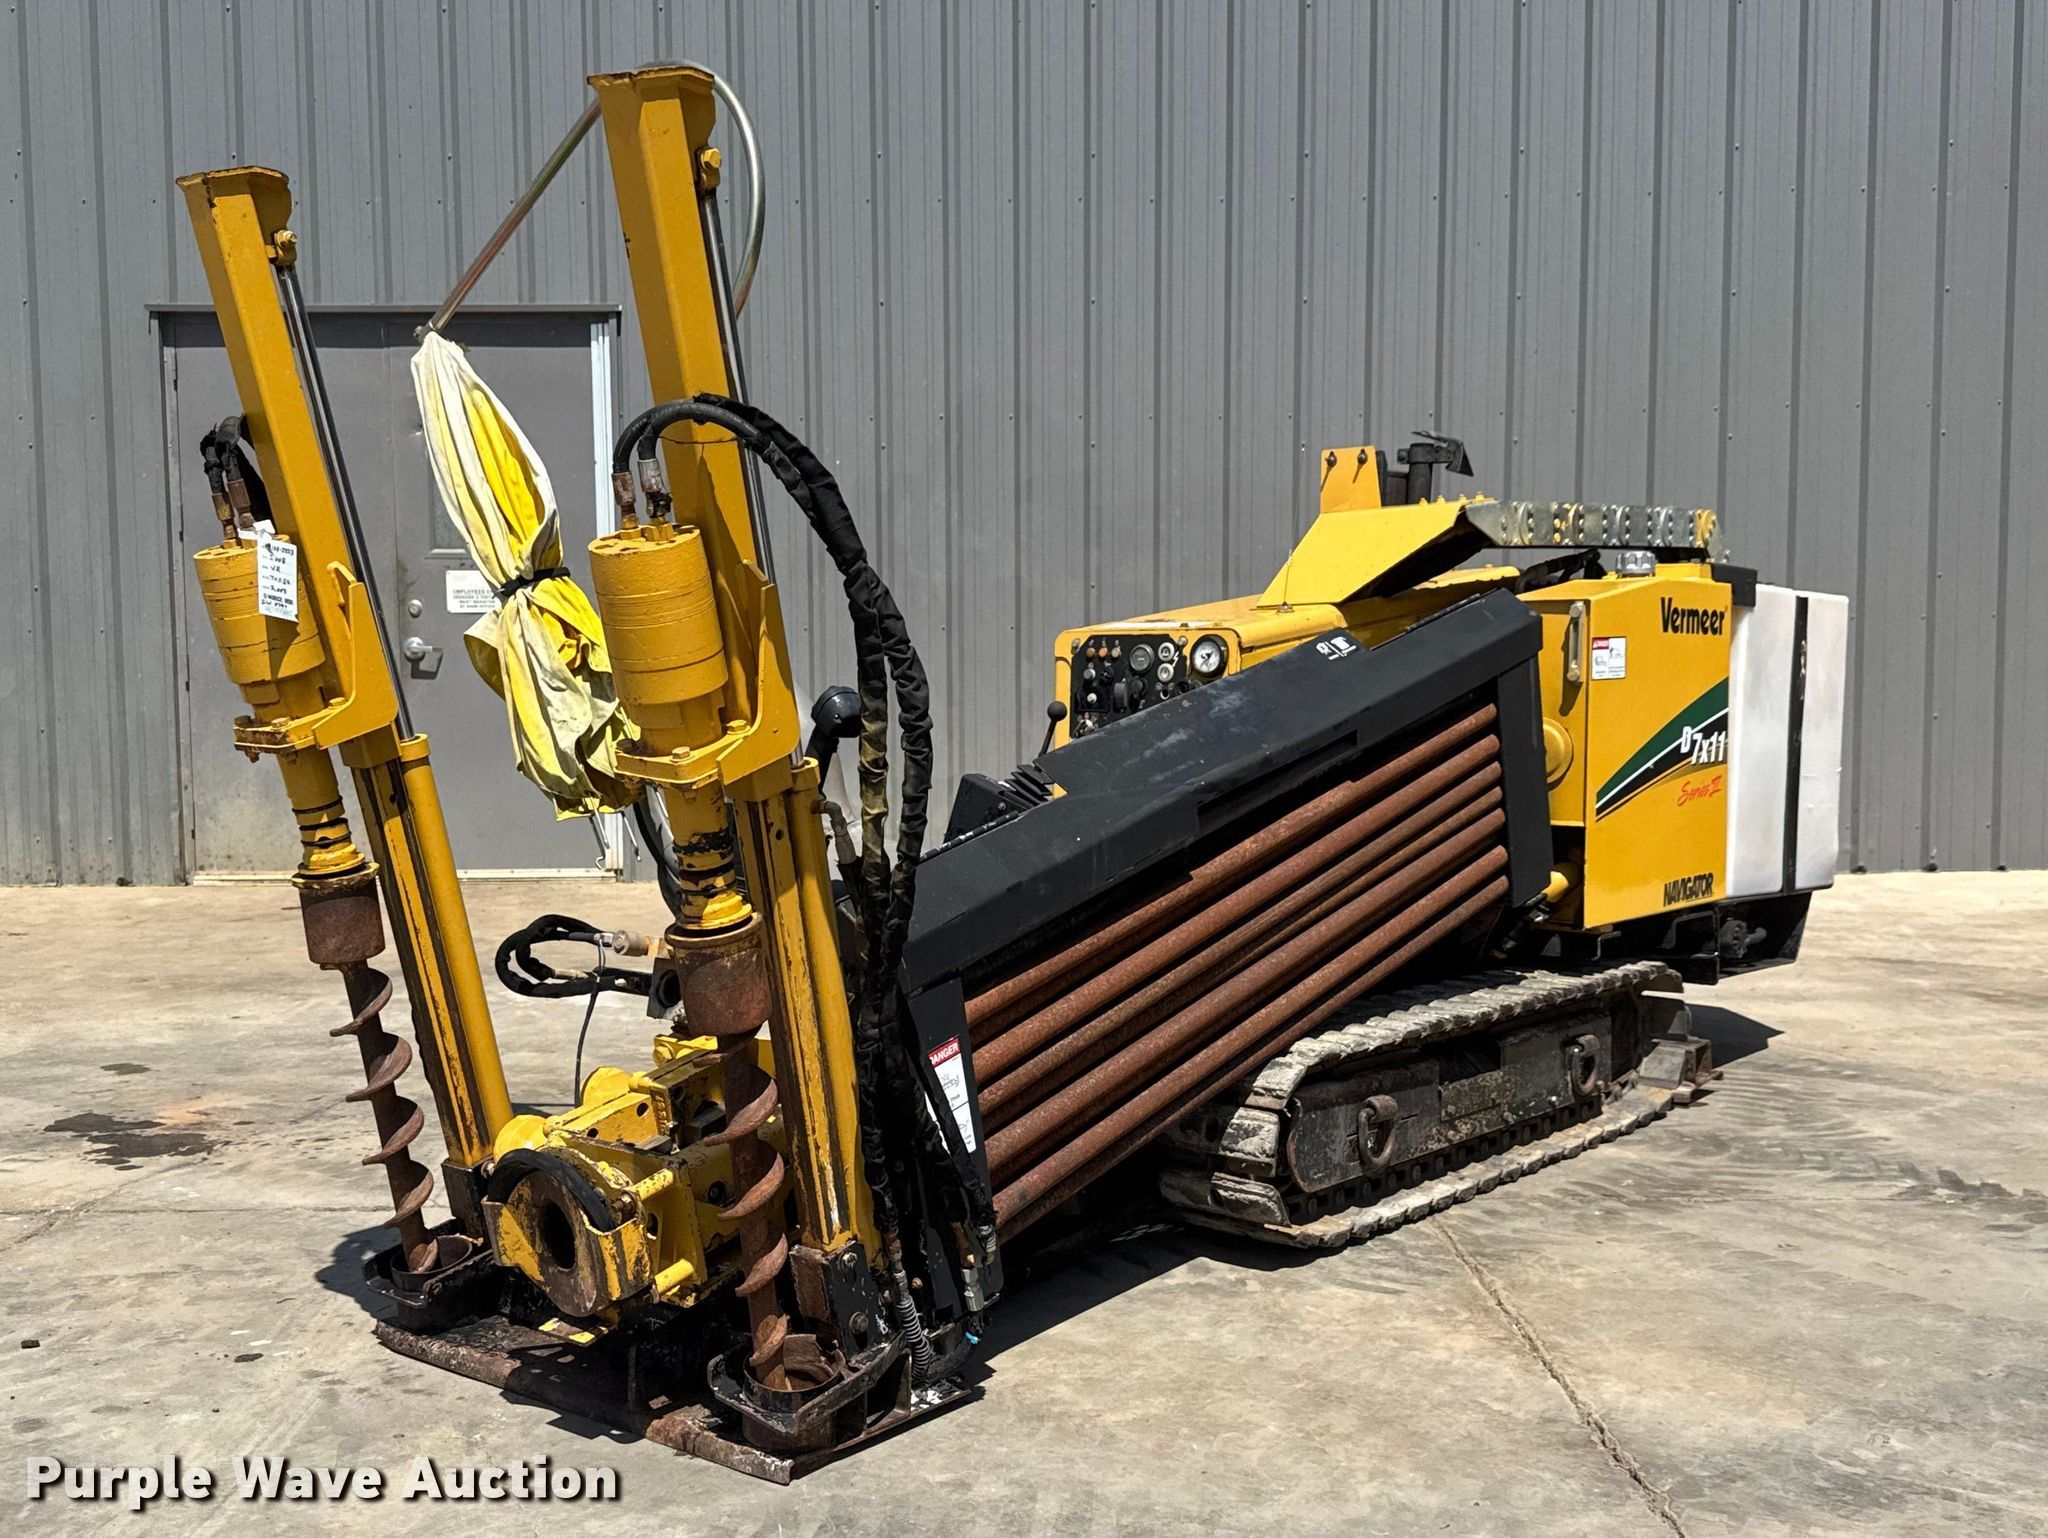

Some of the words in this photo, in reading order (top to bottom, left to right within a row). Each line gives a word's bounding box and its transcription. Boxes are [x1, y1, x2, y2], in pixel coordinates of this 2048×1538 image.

[1660, 596, 1726, 636] Vermeer
[1677, 780, 1710, 807] Series
[1663, 872, 1714, 907] NAVIGATOR
